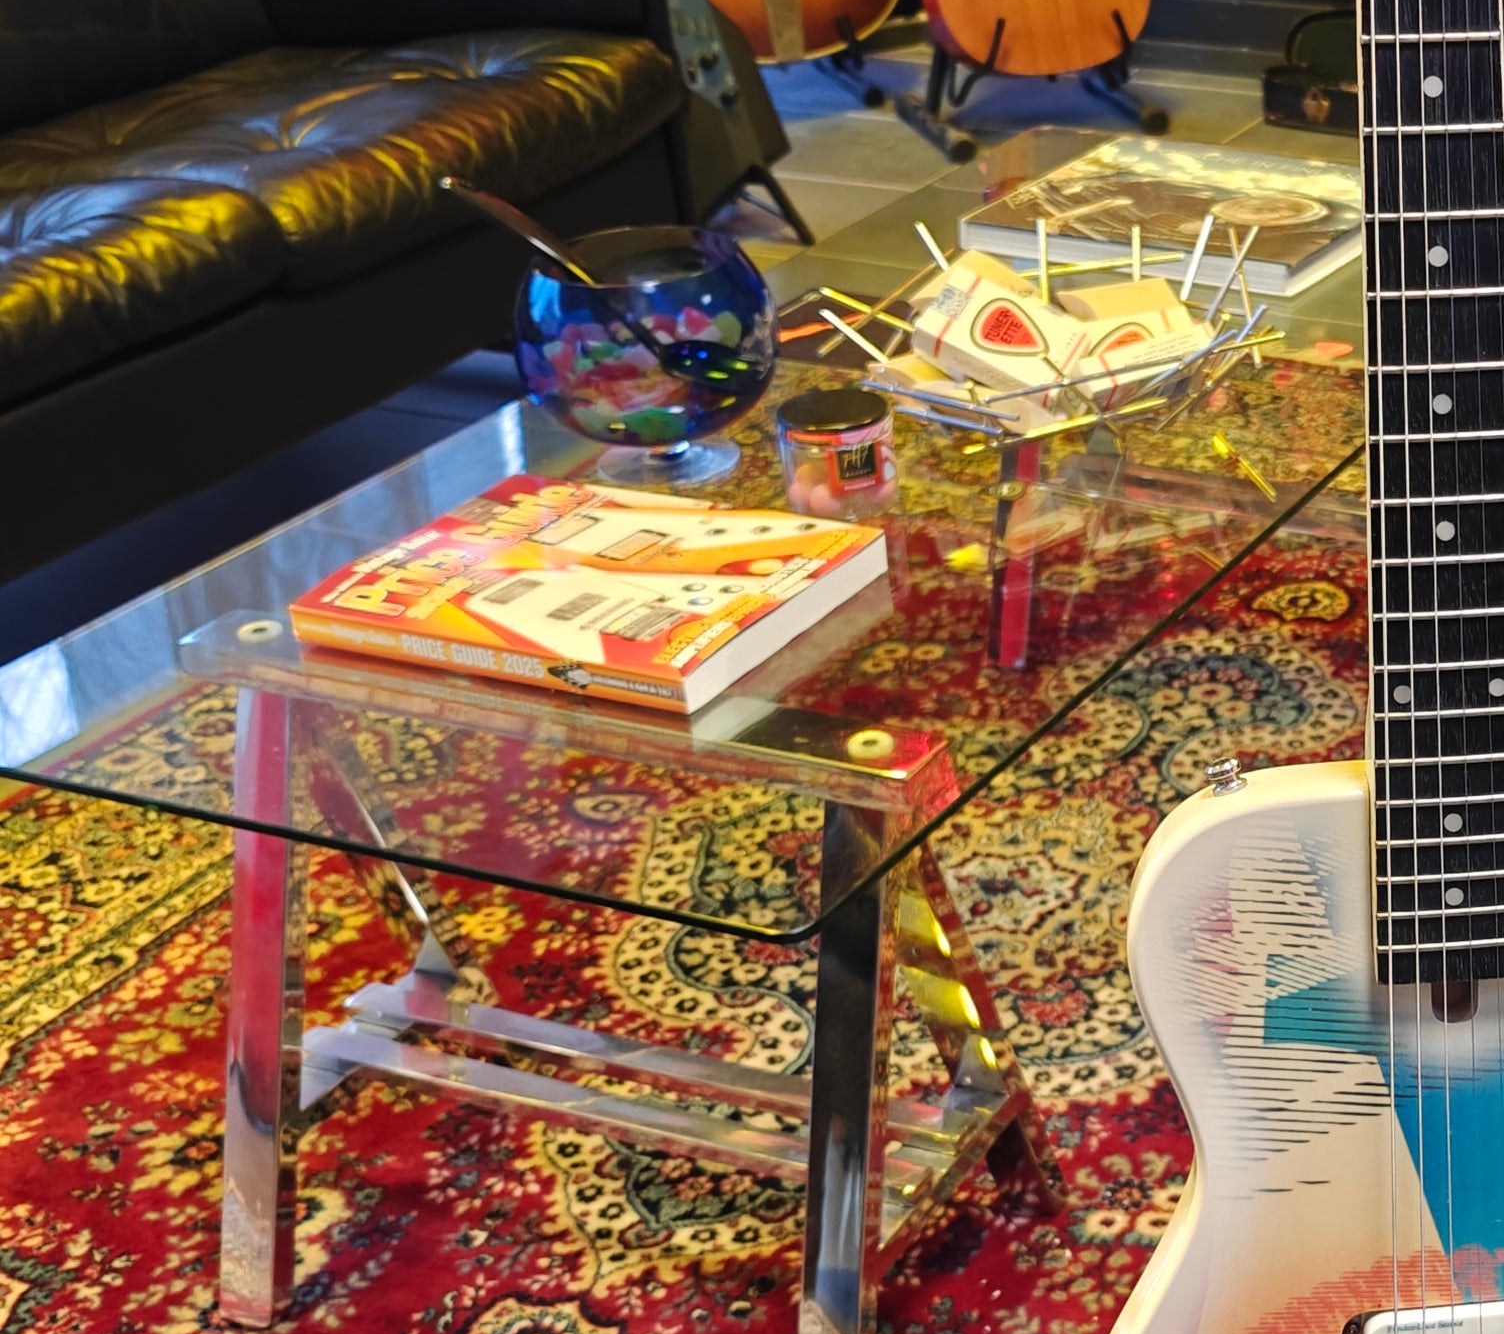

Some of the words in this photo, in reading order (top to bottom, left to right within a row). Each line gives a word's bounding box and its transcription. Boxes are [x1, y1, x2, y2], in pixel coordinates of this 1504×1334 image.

[401, 633, 448, 661] PRICE
[451, 643, 498, 670] GUIDE
[501, 652, 544, 679] 2025
